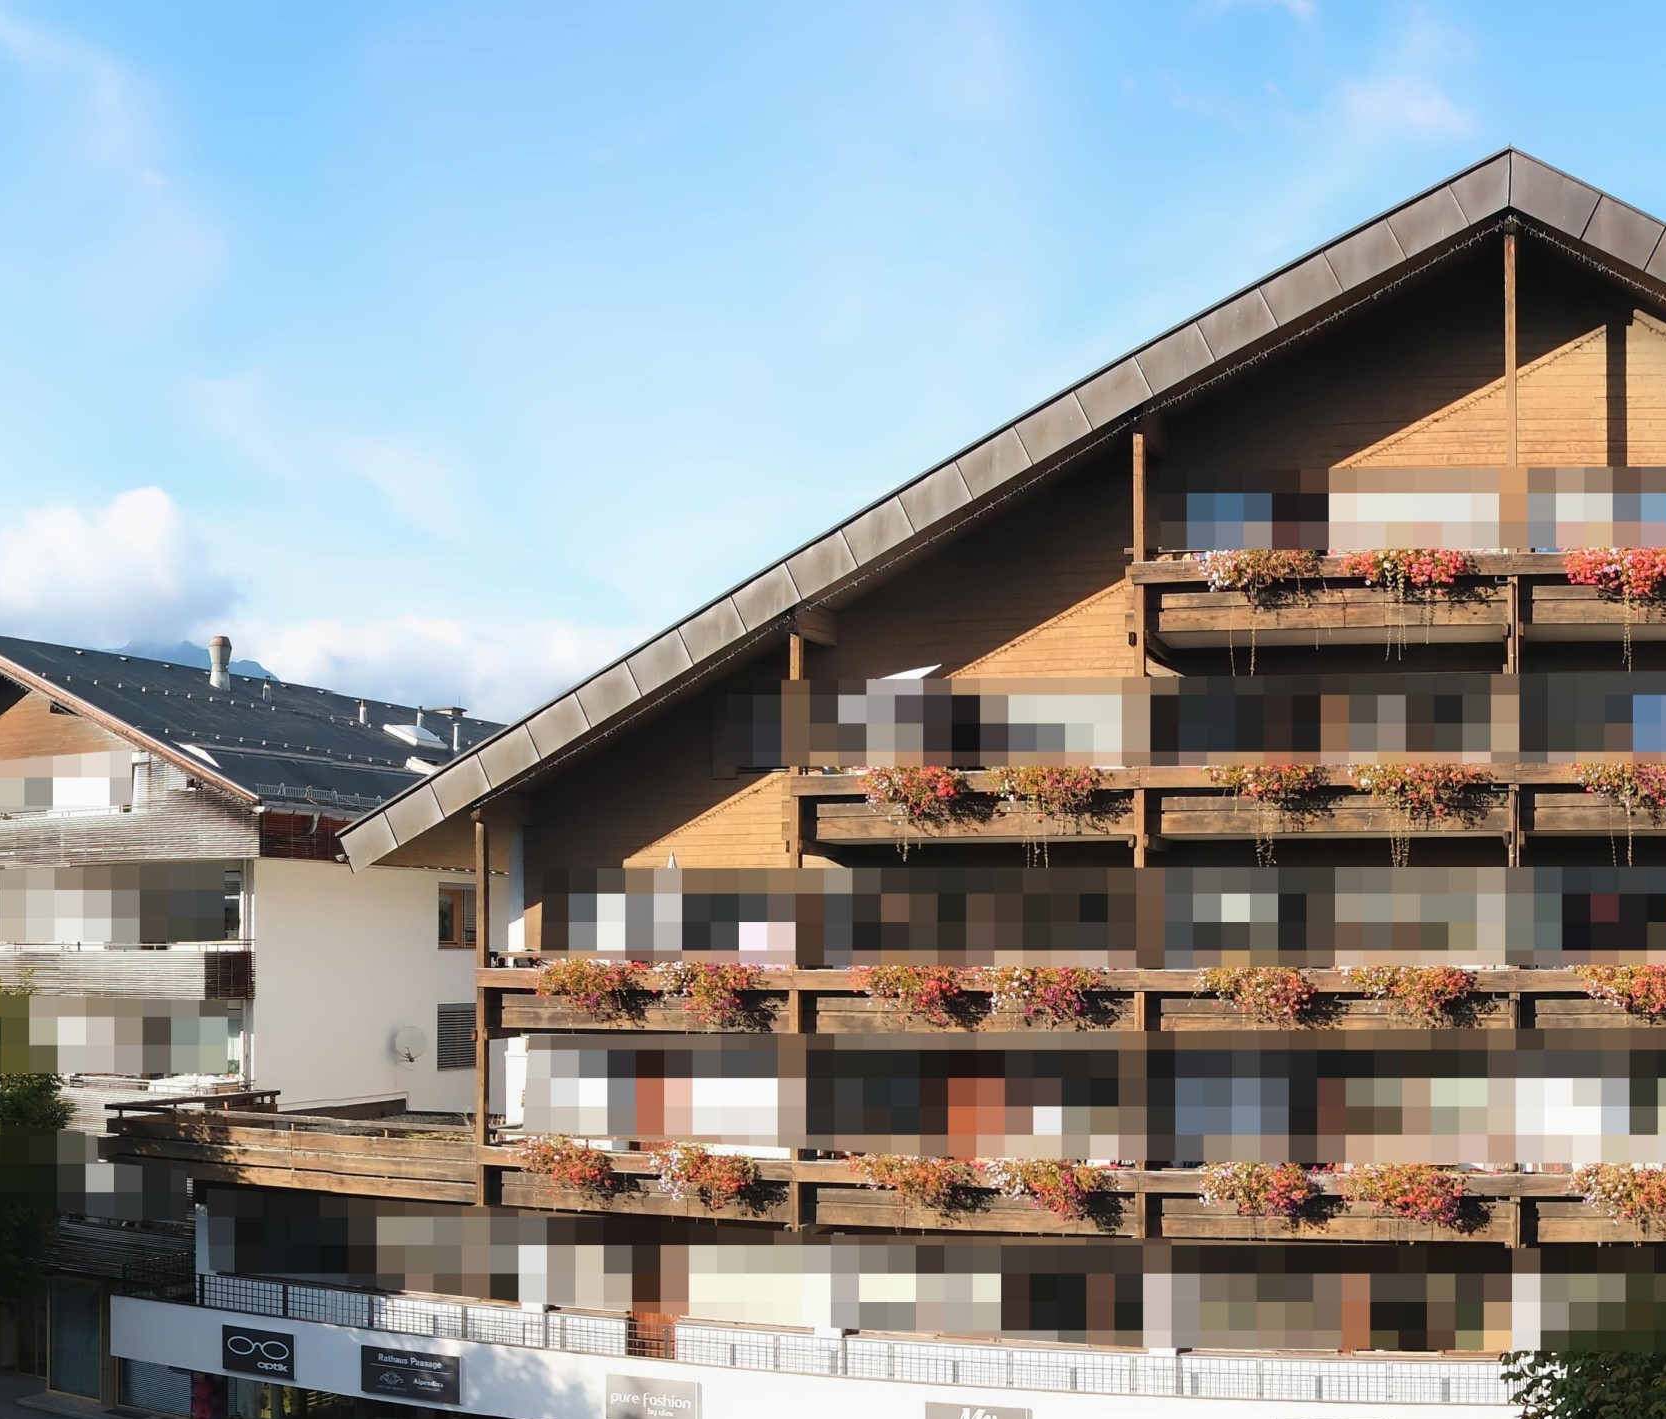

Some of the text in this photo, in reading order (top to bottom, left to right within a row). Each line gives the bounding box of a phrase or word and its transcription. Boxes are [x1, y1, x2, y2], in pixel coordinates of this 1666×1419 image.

[257, 1361, 289, 1372] optik
[378, 1353, 442, 1369] Rathaus Passage
[610, 1392, 691, 1409] pure fashion
[647, 1407, 674, 1417] by alex
